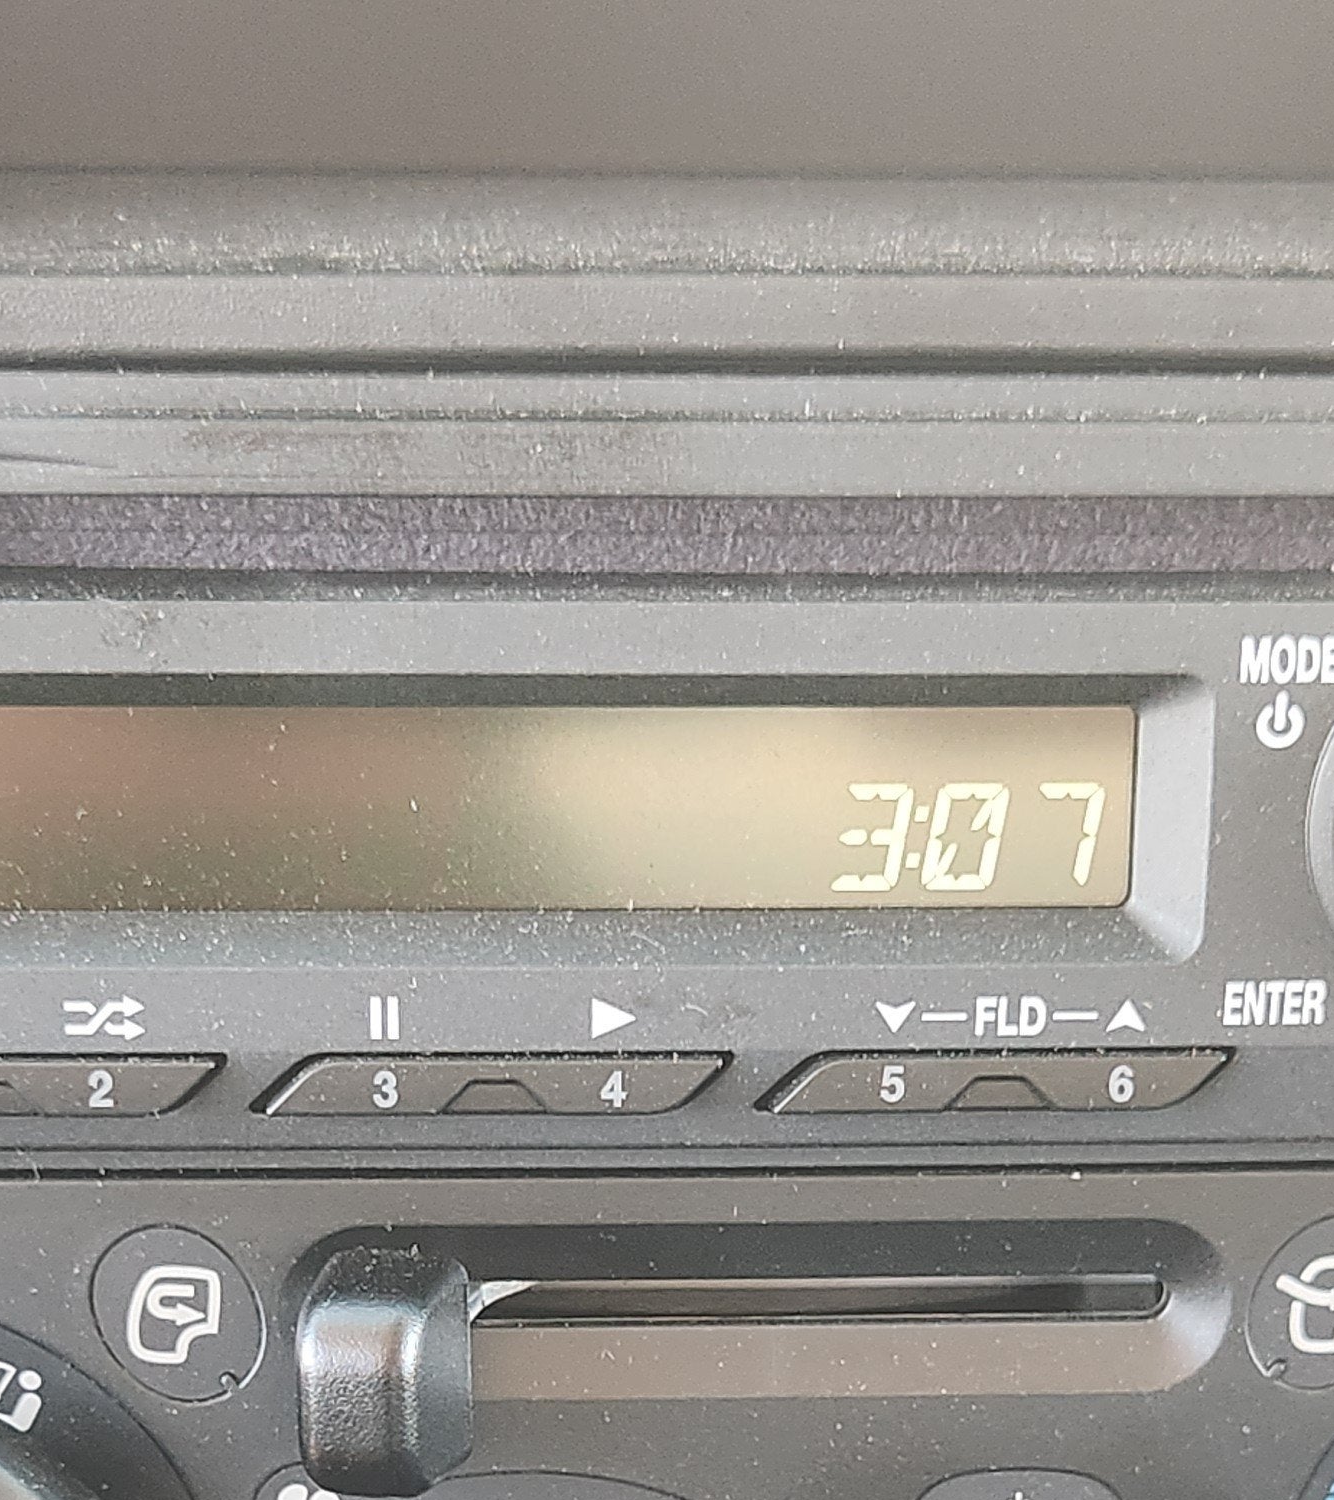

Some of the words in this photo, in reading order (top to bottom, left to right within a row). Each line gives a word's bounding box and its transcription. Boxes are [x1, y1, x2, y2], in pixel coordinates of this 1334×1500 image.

[973, 995, 1048, 1038] FLD
[1222, 979, 1328, 1027] ENTER
[87, 1069, 116, 1109] 2
[371, 1069, 400, 1109] 3
[599, 1069, 628, 1109] 4
[878, 1064, 907, 1105] 5
[1107, 1064, 1136, 1105] 6
